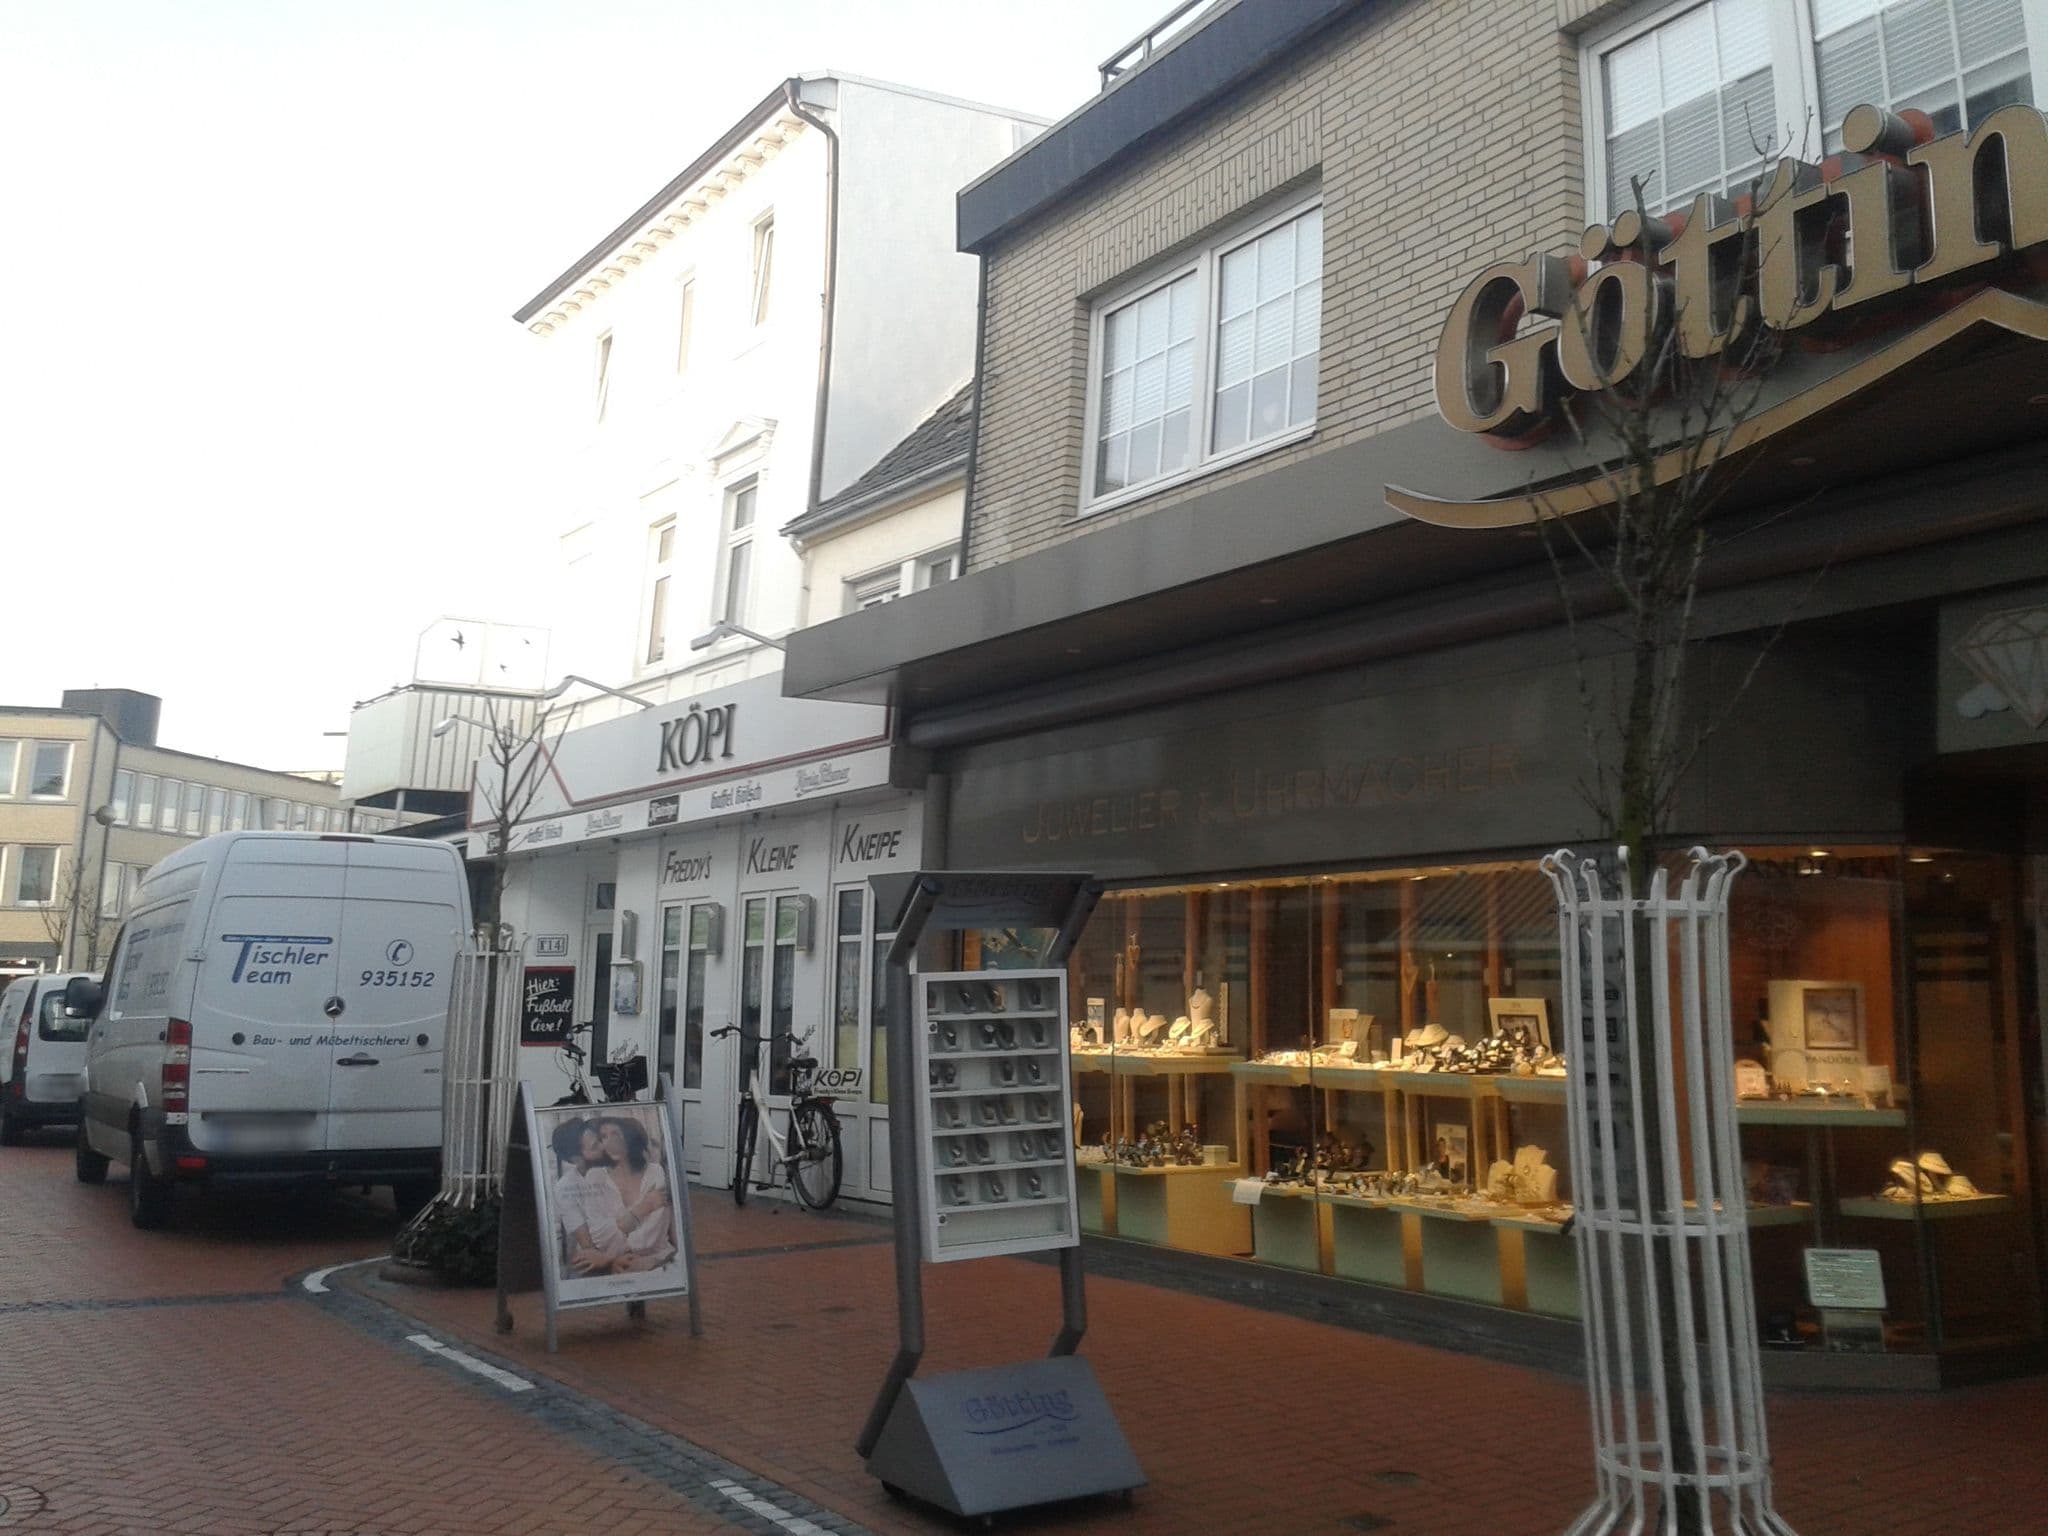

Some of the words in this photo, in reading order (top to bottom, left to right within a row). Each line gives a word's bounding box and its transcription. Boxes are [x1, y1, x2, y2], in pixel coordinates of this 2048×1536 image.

[656, 702, 737, 773] KÖPI
[746, 837, 799, 874] KLEINE
[840, 823, 902, 863] KNEIPE
[222, 934, 333, 979] Tischler
[359, 970, 435, 987] 935152
[526, 996, 572, 1014] Fußball
[253, 1034, 282, 1046] Bau-
[289, 1035, 311, 1046] und
[316, 1034, 410, 1046] Möbeltischlerei
